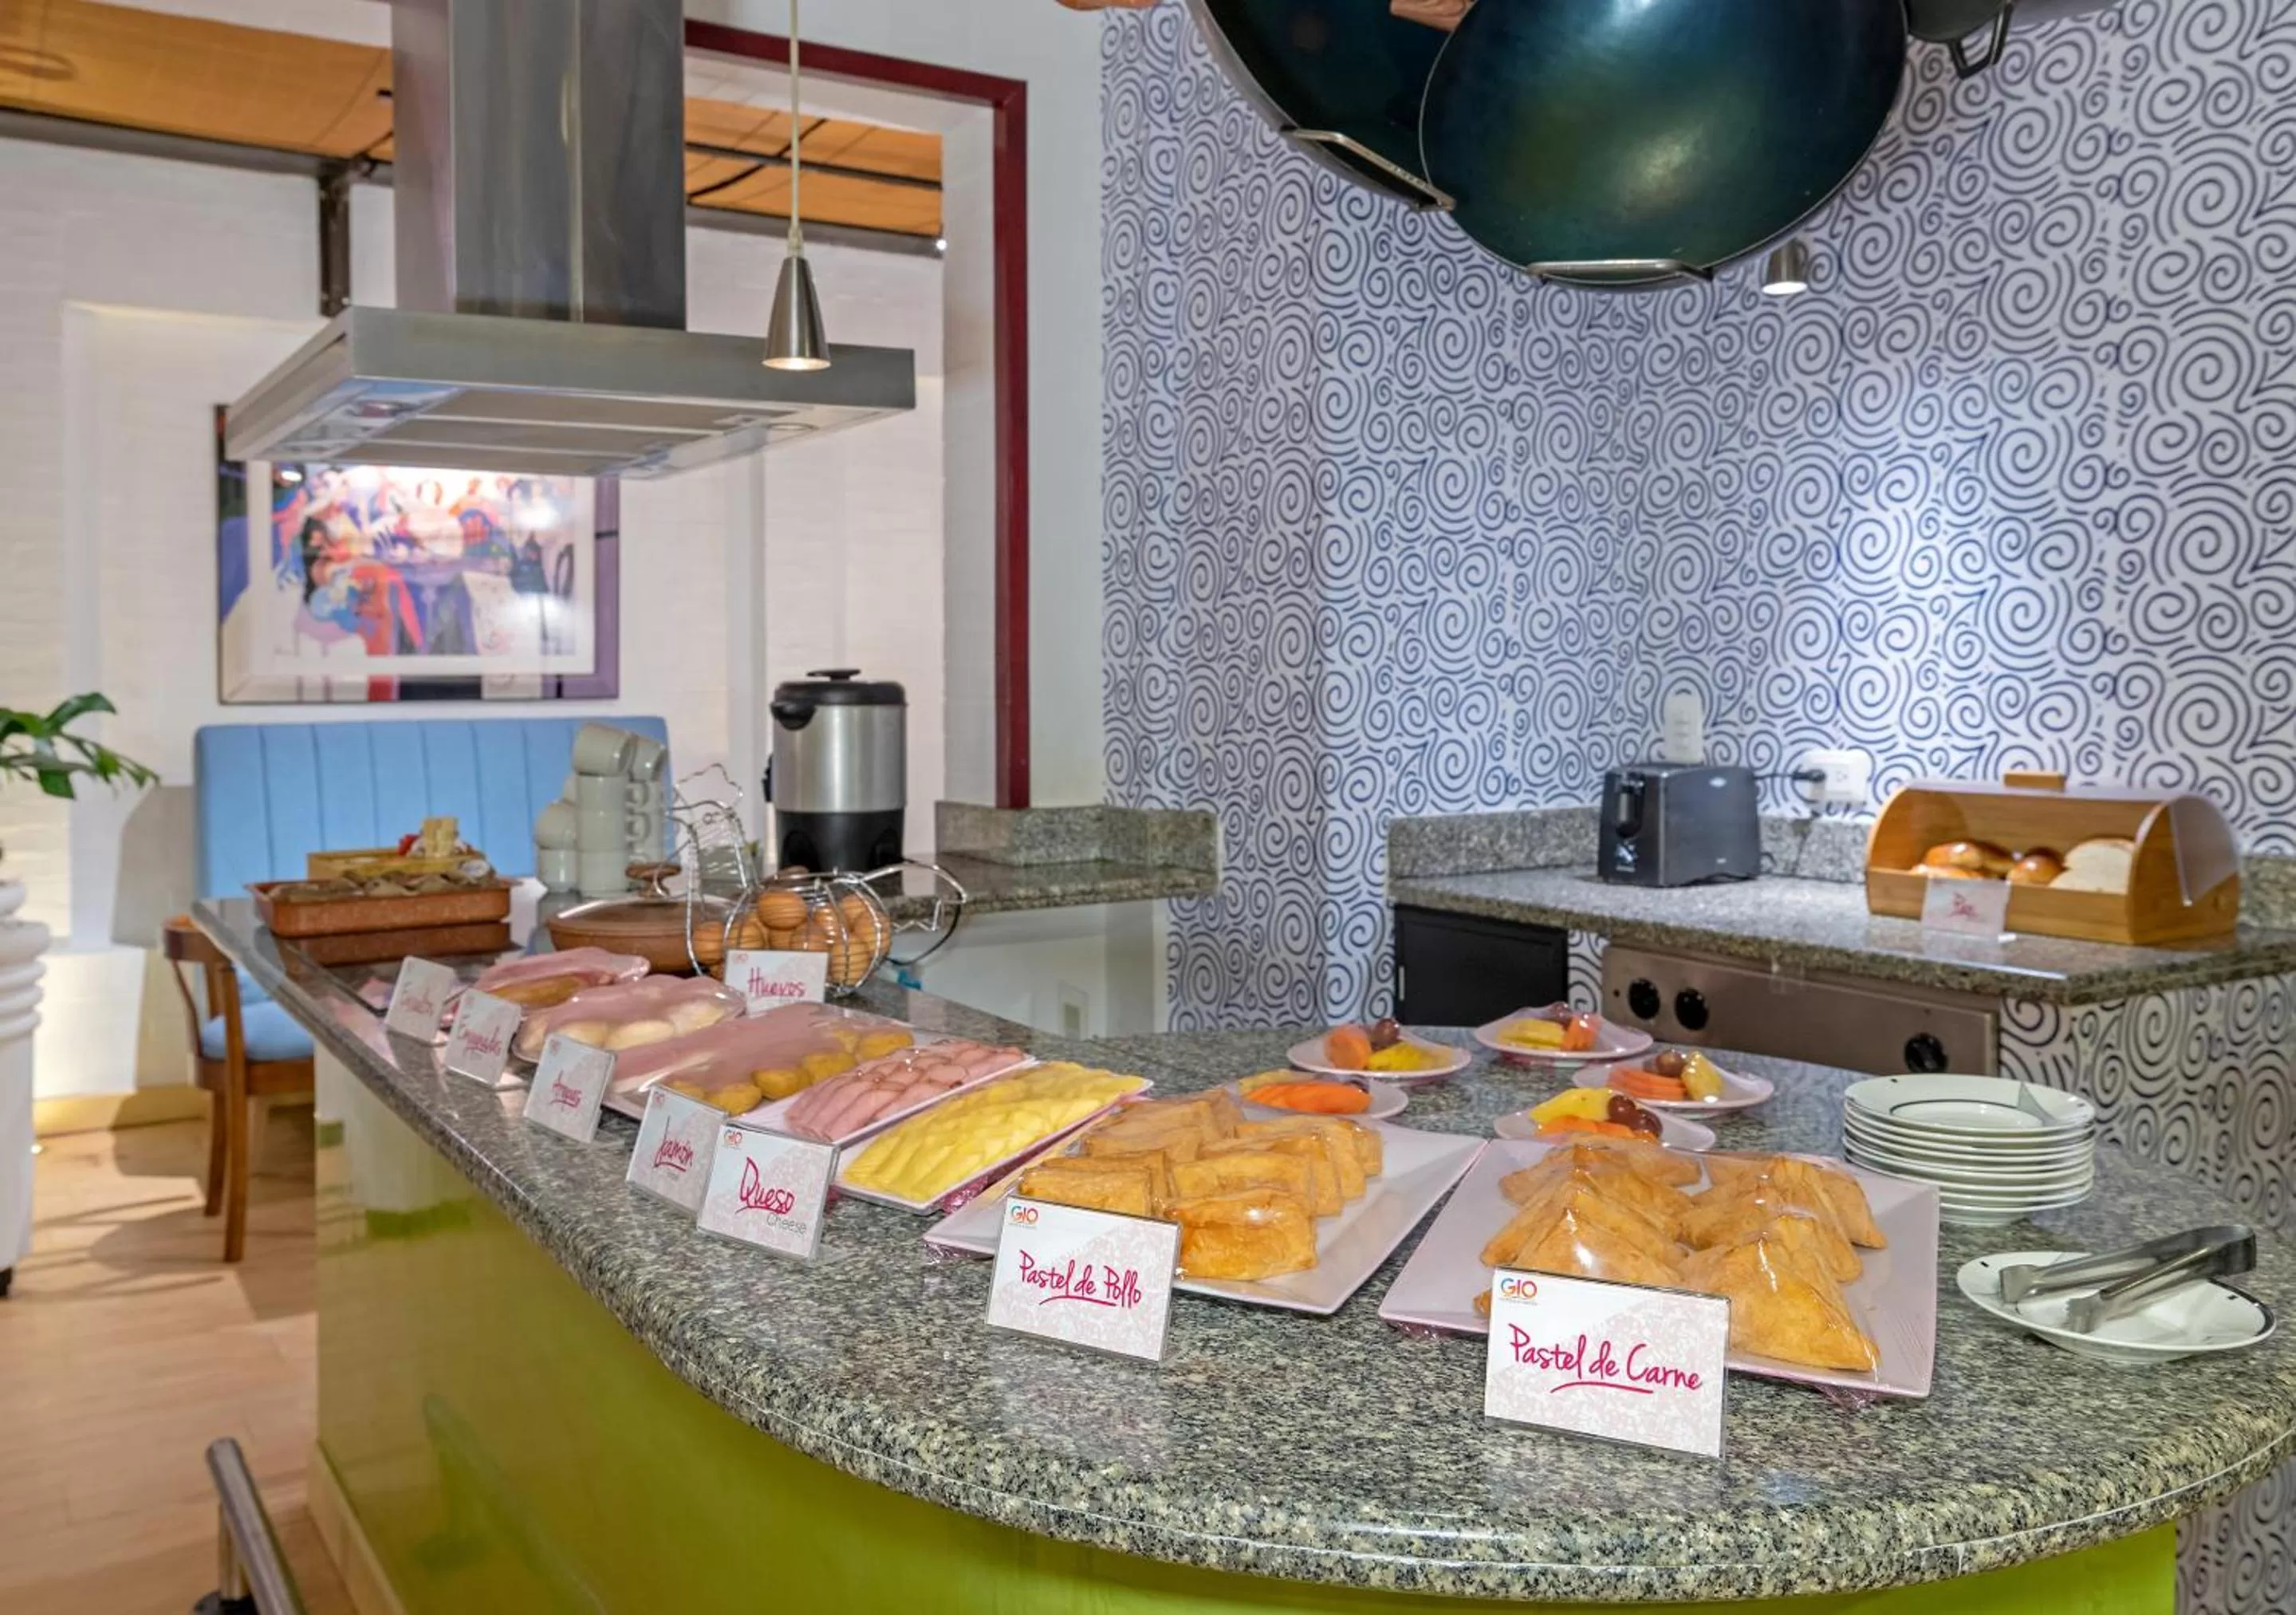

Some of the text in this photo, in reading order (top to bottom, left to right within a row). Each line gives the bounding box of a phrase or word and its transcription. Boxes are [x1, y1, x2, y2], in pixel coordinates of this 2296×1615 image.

[747, 966, 805, 998] Huevos
[737, 1156, 795, 1215] Queso
[766, 1214, 807, 1235] Cheese
[1010, 1205, 1038, 1223] GIO
[1018, 1249, 1142, 1309] Pastel de Pollo
[1500, 1277, 1538, 1298] GIO
[1508, 1322, 1703, 1391] Pastel de Carne
